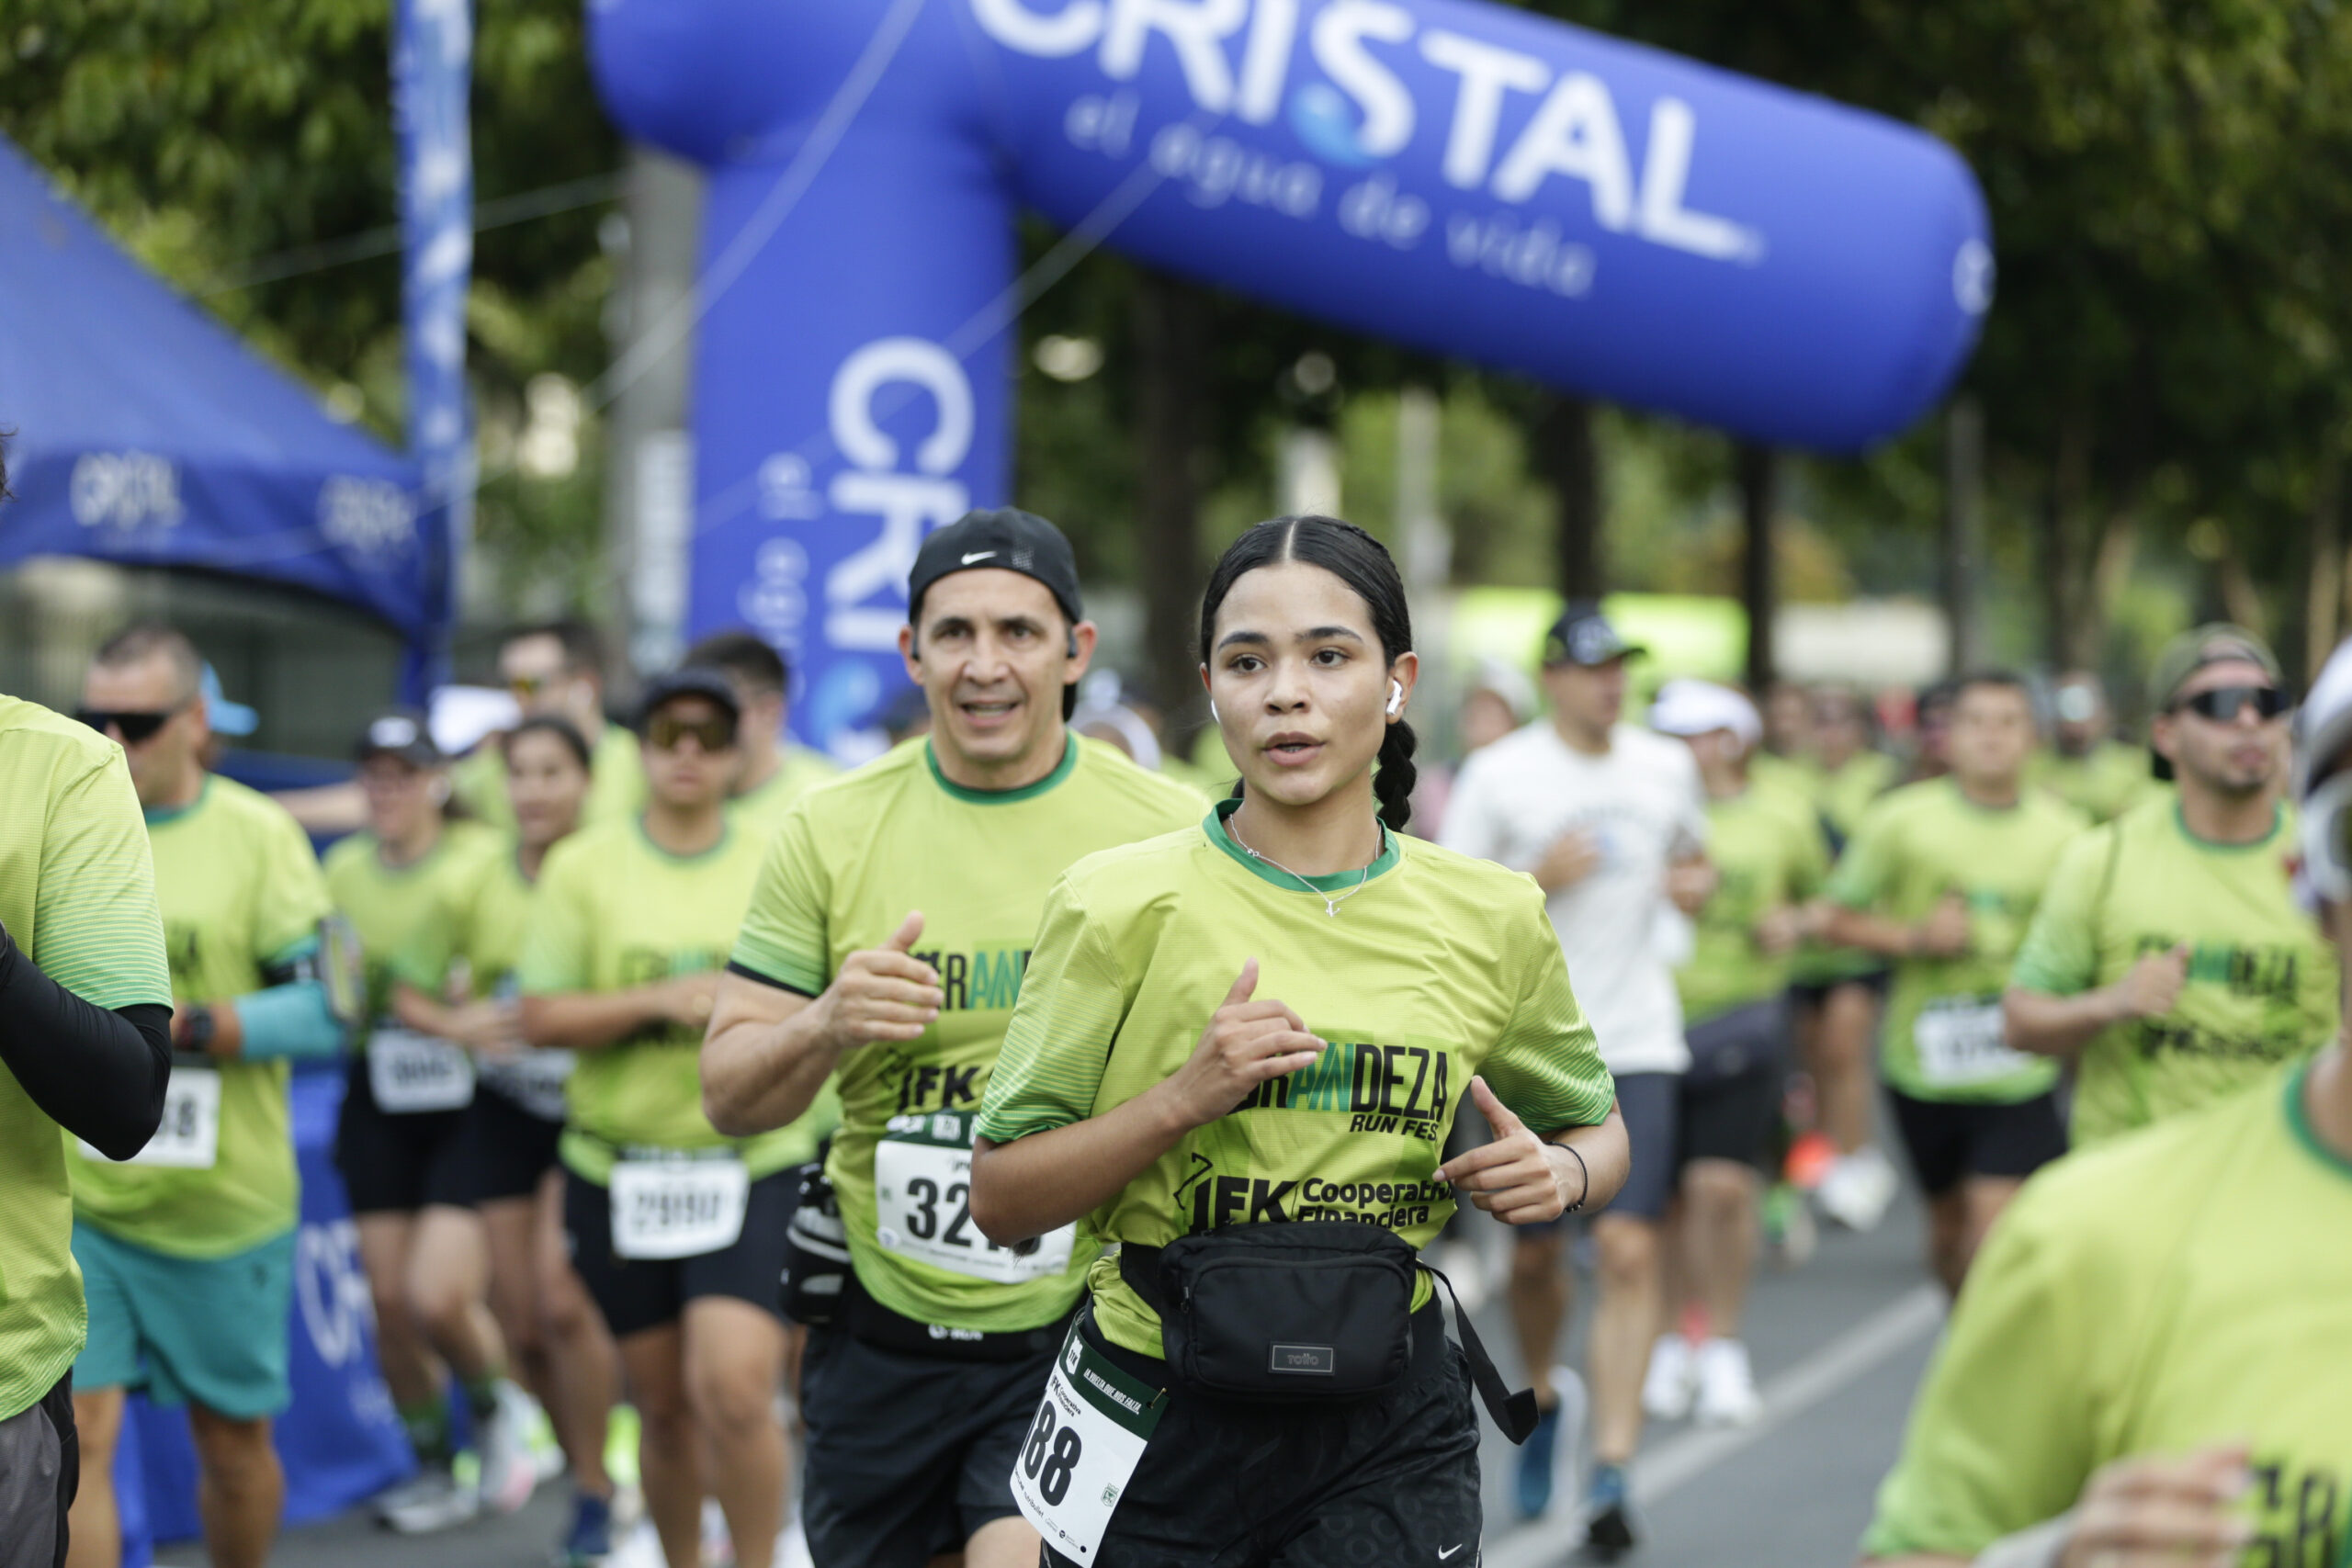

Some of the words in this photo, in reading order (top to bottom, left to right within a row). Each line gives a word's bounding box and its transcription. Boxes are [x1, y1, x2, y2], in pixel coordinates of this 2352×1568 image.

[1065, 90, 1140, 159] el
[1149, 123, 1323, 209] agua
[1339, 172, 1430, 250] de
[1446, 209, 1597, 300] vida
[825, 334, 976, 767] CRI
[911, 950, 1033, 1010] RAN
[1350, 1114, 1398, 1134] RUN
[1401, 1120, 1440, 1142] FES
[1303, 1177, 1454, 1210] Cooperativ
[1069, 1349, 1079, 1367] 11K
[1089, 1371, 1106, 1391] VUELTA
[1104, 1383, 1116, 1397] QUE
[1114, 1390, 1127, 1404] NOS
[1021, 1389, 1082, 1506] 88
